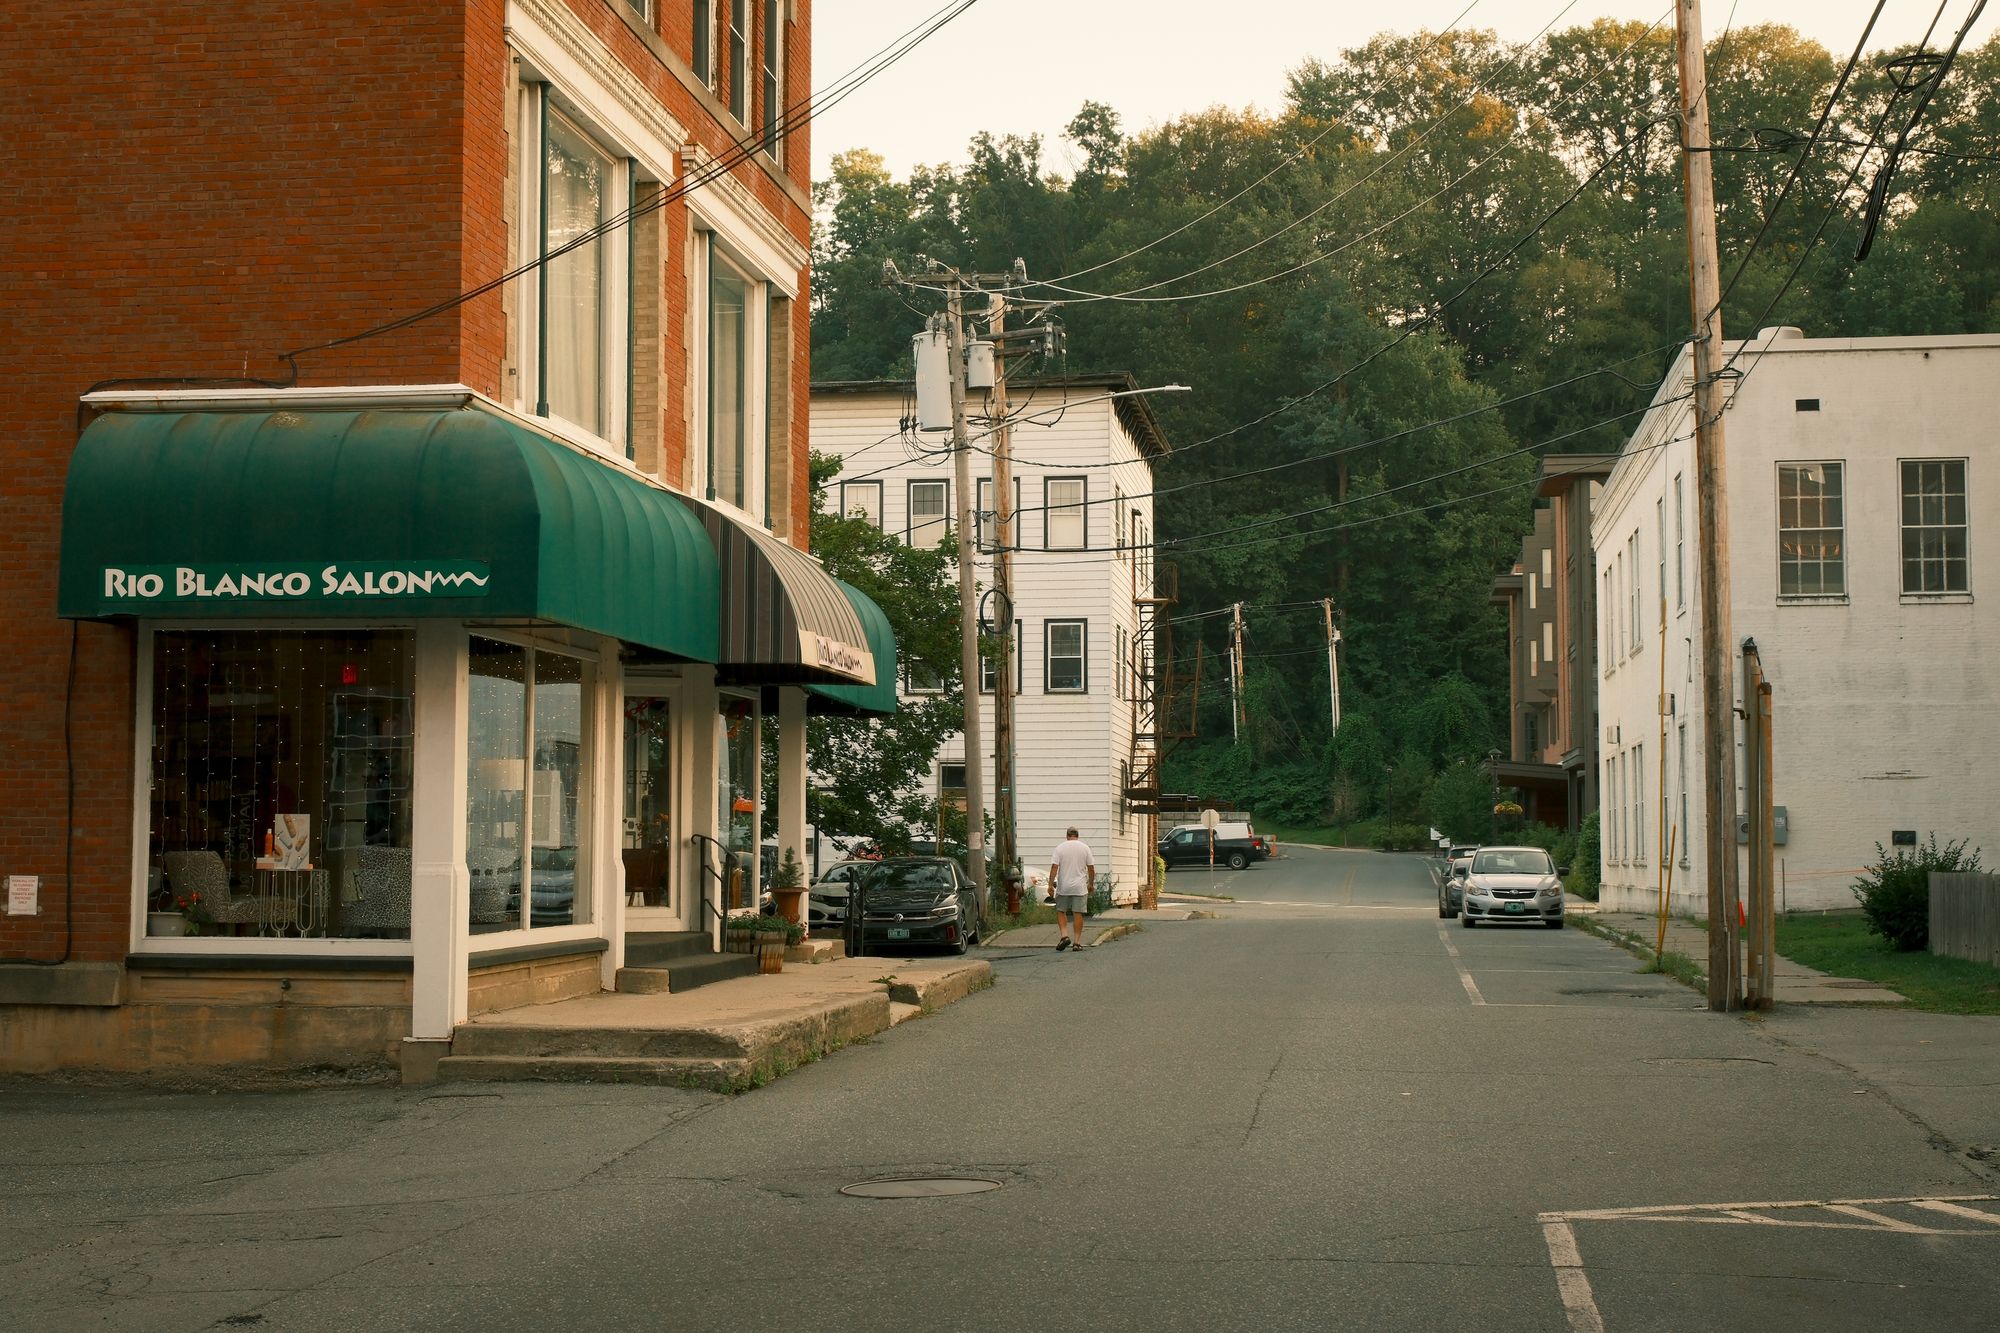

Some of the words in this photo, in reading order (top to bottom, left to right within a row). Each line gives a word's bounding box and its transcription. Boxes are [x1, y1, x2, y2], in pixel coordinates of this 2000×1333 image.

[105, 568, 164, 598] RIO
[176, 567, 311, 597] BLANCO
[321, 565, 433, 596] SALON
